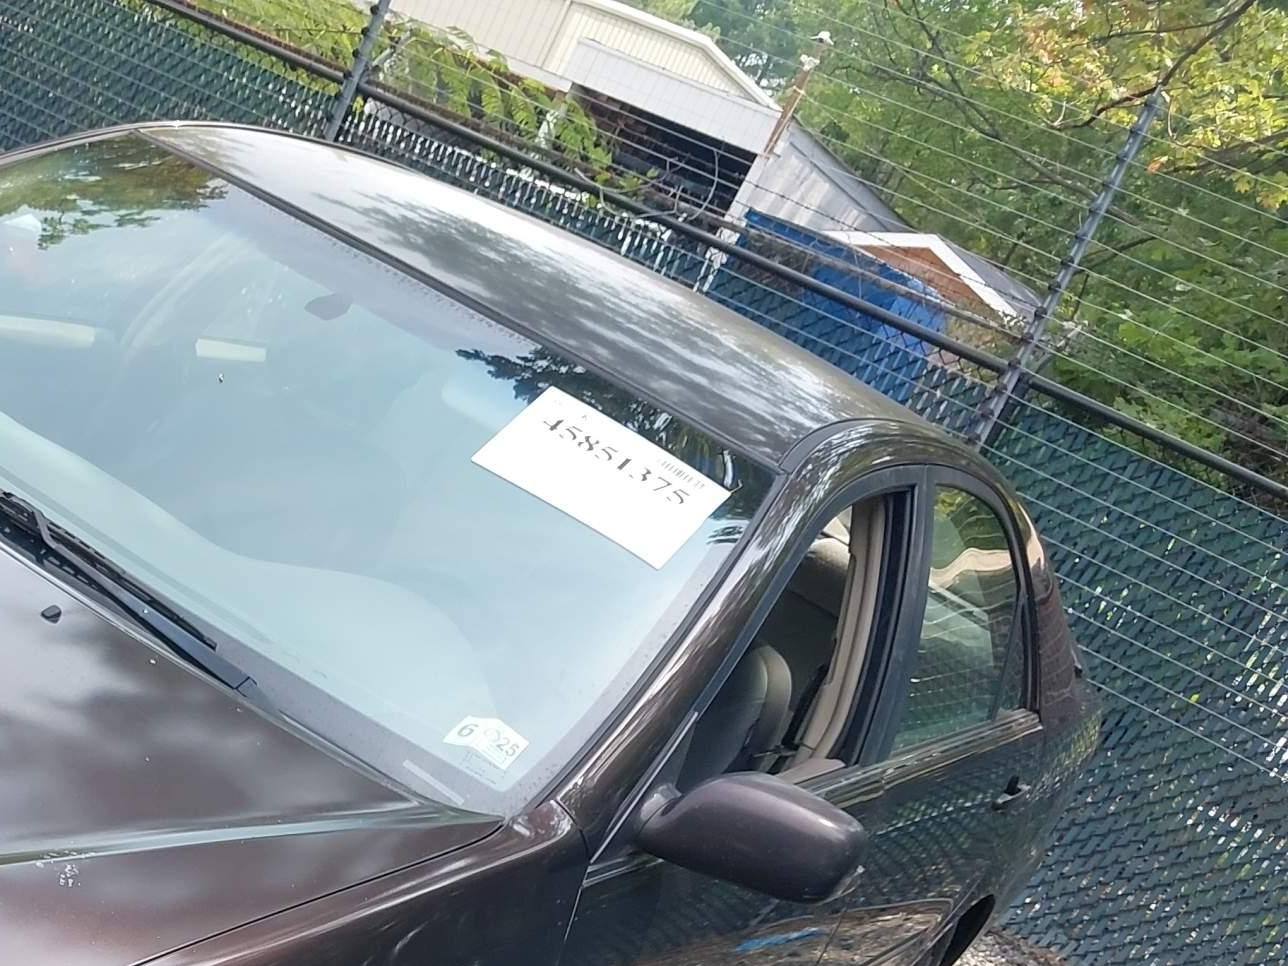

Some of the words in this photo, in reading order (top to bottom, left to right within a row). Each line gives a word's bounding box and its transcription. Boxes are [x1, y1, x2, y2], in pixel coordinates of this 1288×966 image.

[542, 417, 691, 506] 45851375
[457, 723, 480, 738] 6
[495, 736, 520, 757] 25
